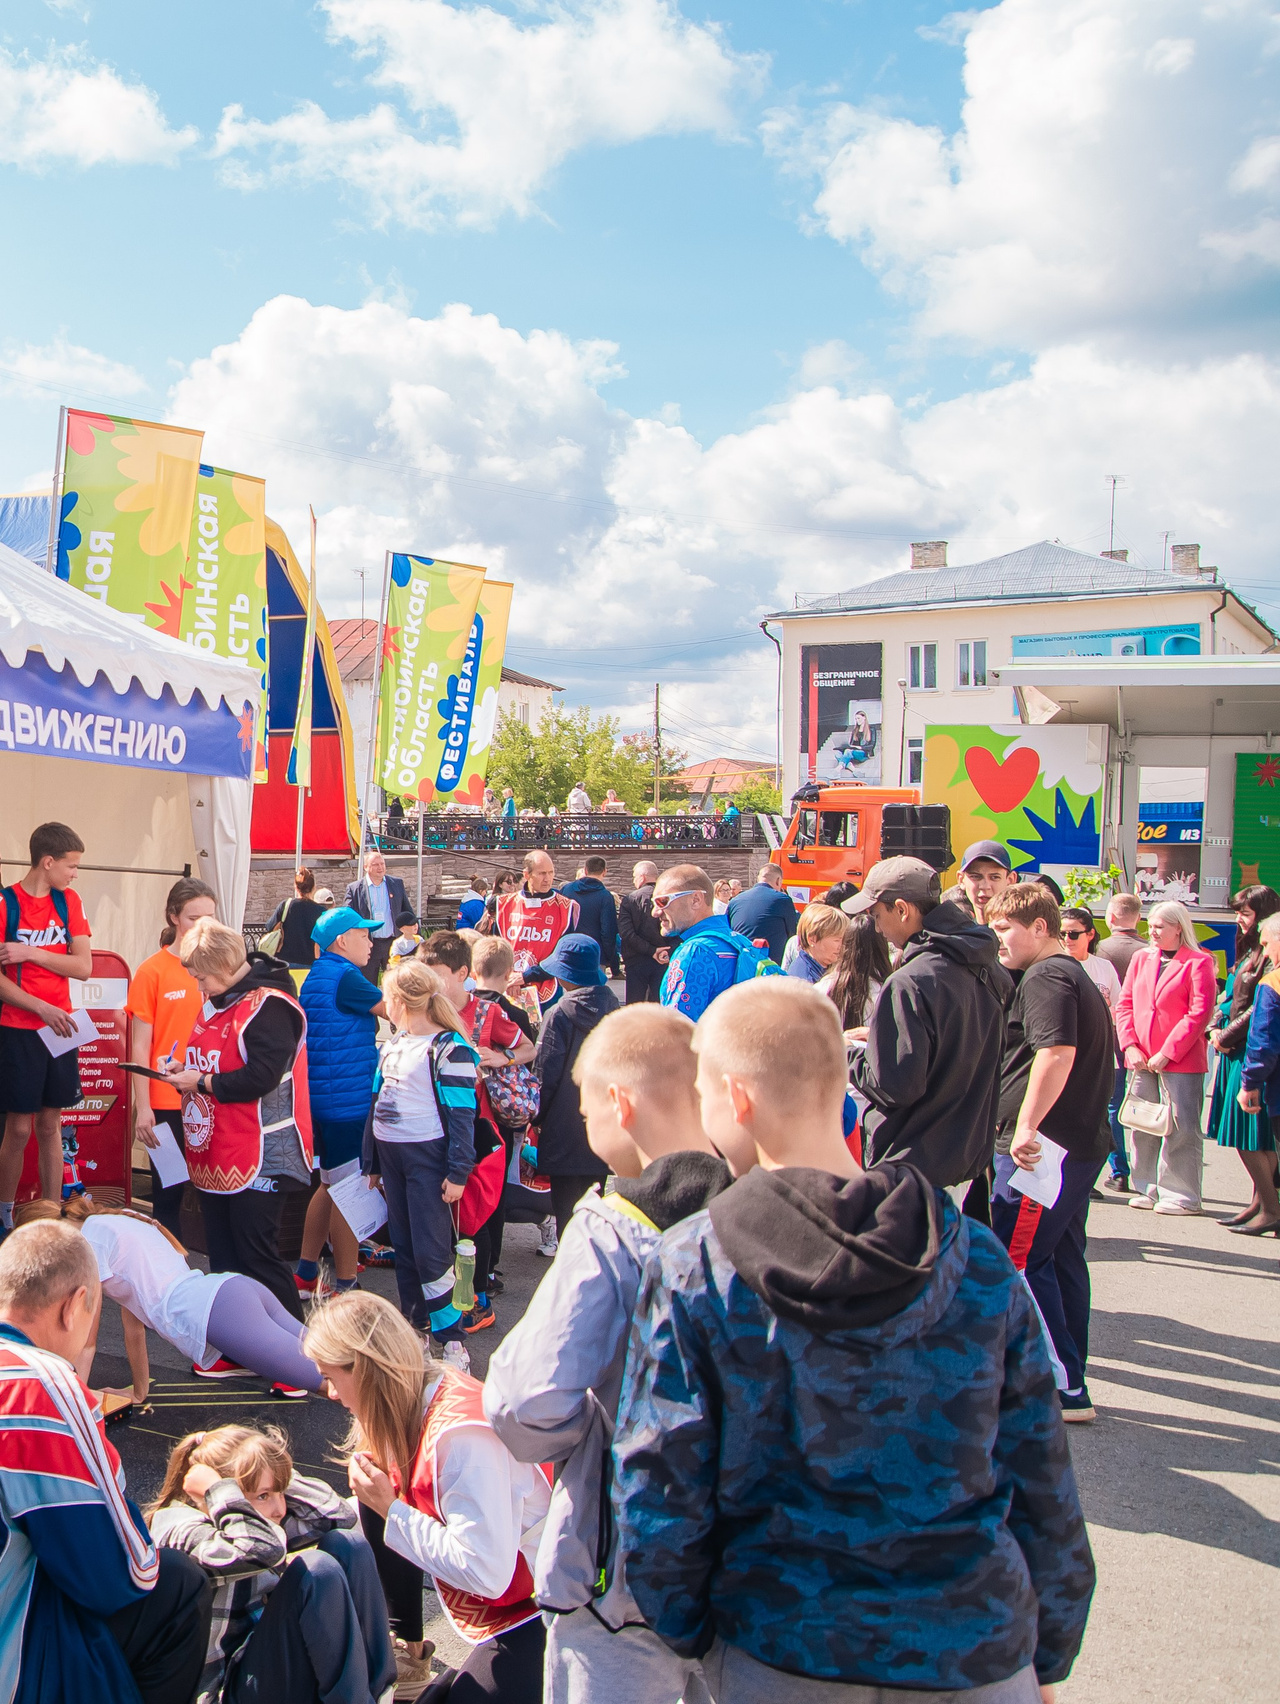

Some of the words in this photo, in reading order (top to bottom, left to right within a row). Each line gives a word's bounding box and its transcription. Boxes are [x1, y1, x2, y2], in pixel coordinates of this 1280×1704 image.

[186, 493, 219, 653] бинская
[813, 670, 879, 679] БЕЗГРАНИЧНОЕ
[813, 679, 856, 687] ОБЩЕНИЕ
[397, 661, 439, 787] область
[77, 1057, 119, 1065] портивного
[184, 1046, 221, 1074] ДЬЯ
